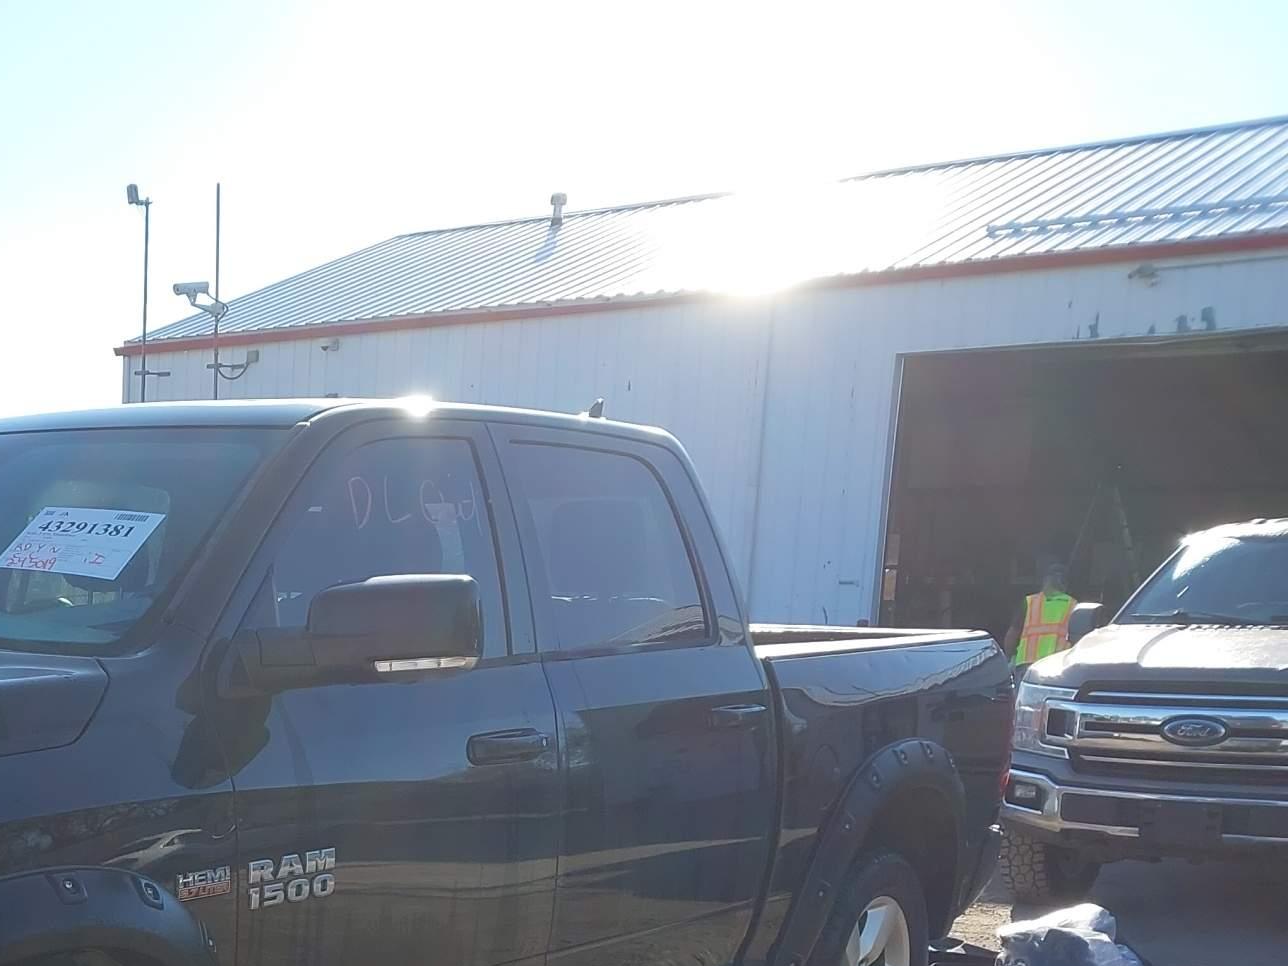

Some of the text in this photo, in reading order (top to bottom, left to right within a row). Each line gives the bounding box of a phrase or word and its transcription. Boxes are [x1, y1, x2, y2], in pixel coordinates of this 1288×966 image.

[38, 519, 136, 538] 43291381
[1177, 724, 1211, 737] Ford
[177, 865, 231, 889] HEMI
[248, 847, 337, 884] RAM
[248, 873, 336, 911] 1500
